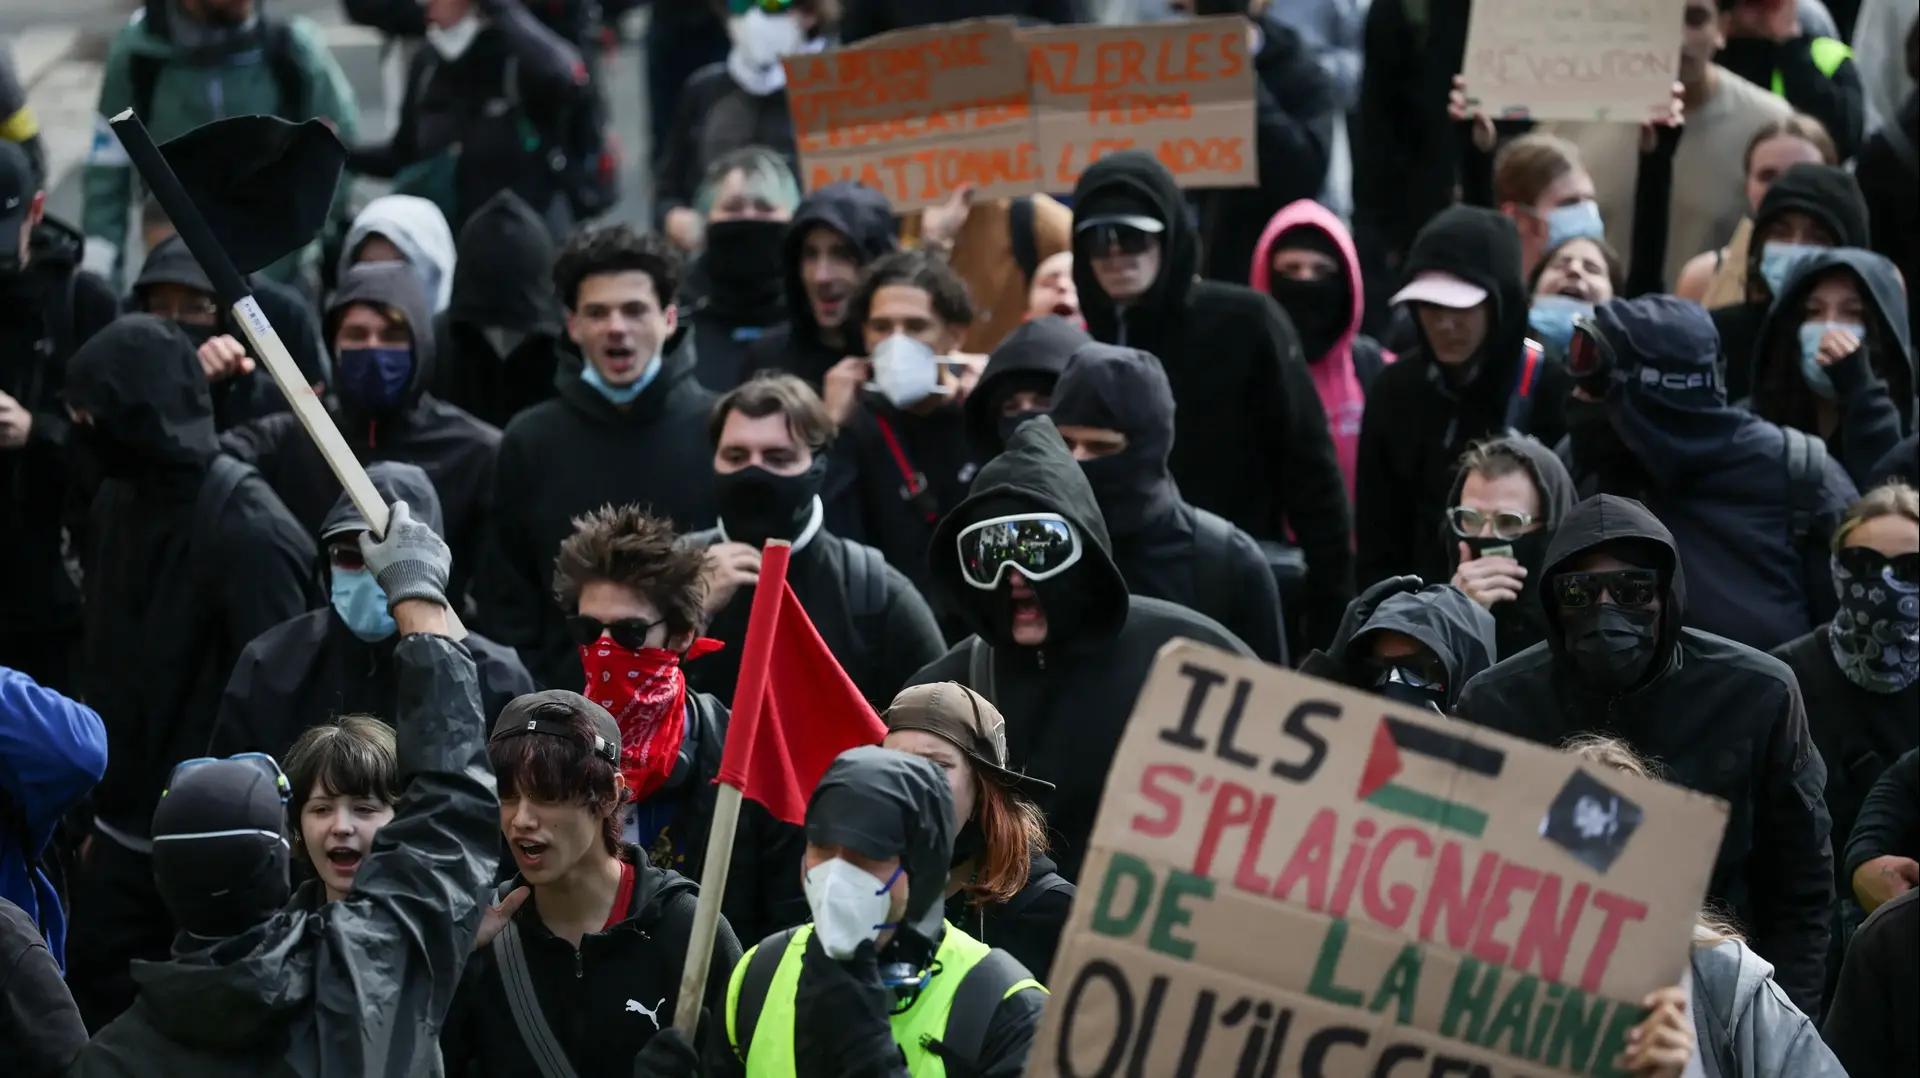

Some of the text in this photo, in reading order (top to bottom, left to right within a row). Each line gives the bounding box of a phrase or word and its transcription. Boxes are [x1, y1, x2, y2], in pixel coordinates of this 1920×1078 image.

[784, 57, 830, 88] LA
[1155, 33, 1244, 84] LES
[1156, 136, 1243, 174] ADOS
[1158, 661, 1343, 784] ILS
[1089, 851, 1217, 960] DE
[1307, 917, 1425, 1026] LA
